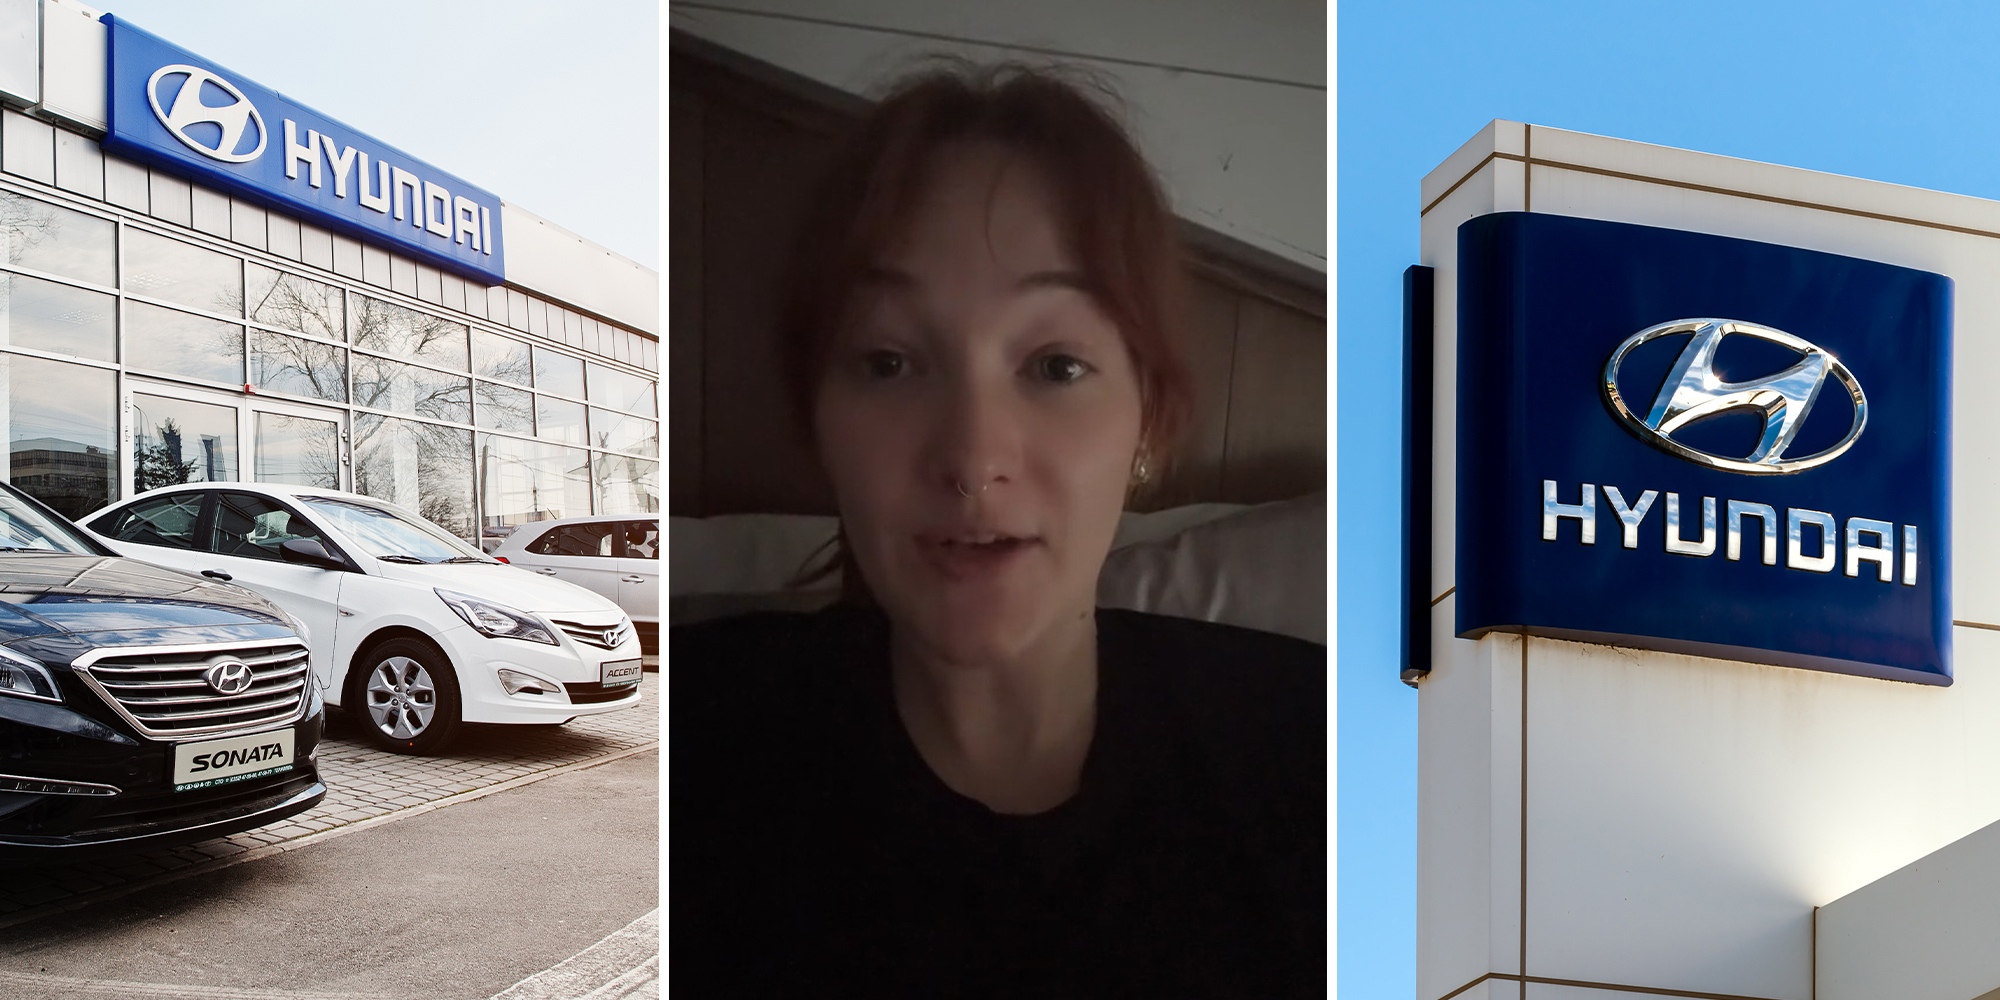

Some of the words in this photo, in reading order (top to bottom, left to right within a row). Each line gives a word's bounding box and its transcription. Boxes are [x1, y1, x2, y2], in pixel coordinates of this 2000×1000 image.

[283, 118, 492, 255] HYUNDAI
[1541, 479, 1918, 587] HYUNDAI
[606, 667, 640, 679] ACCENT
[190, 743, 284, 773] SONATA
